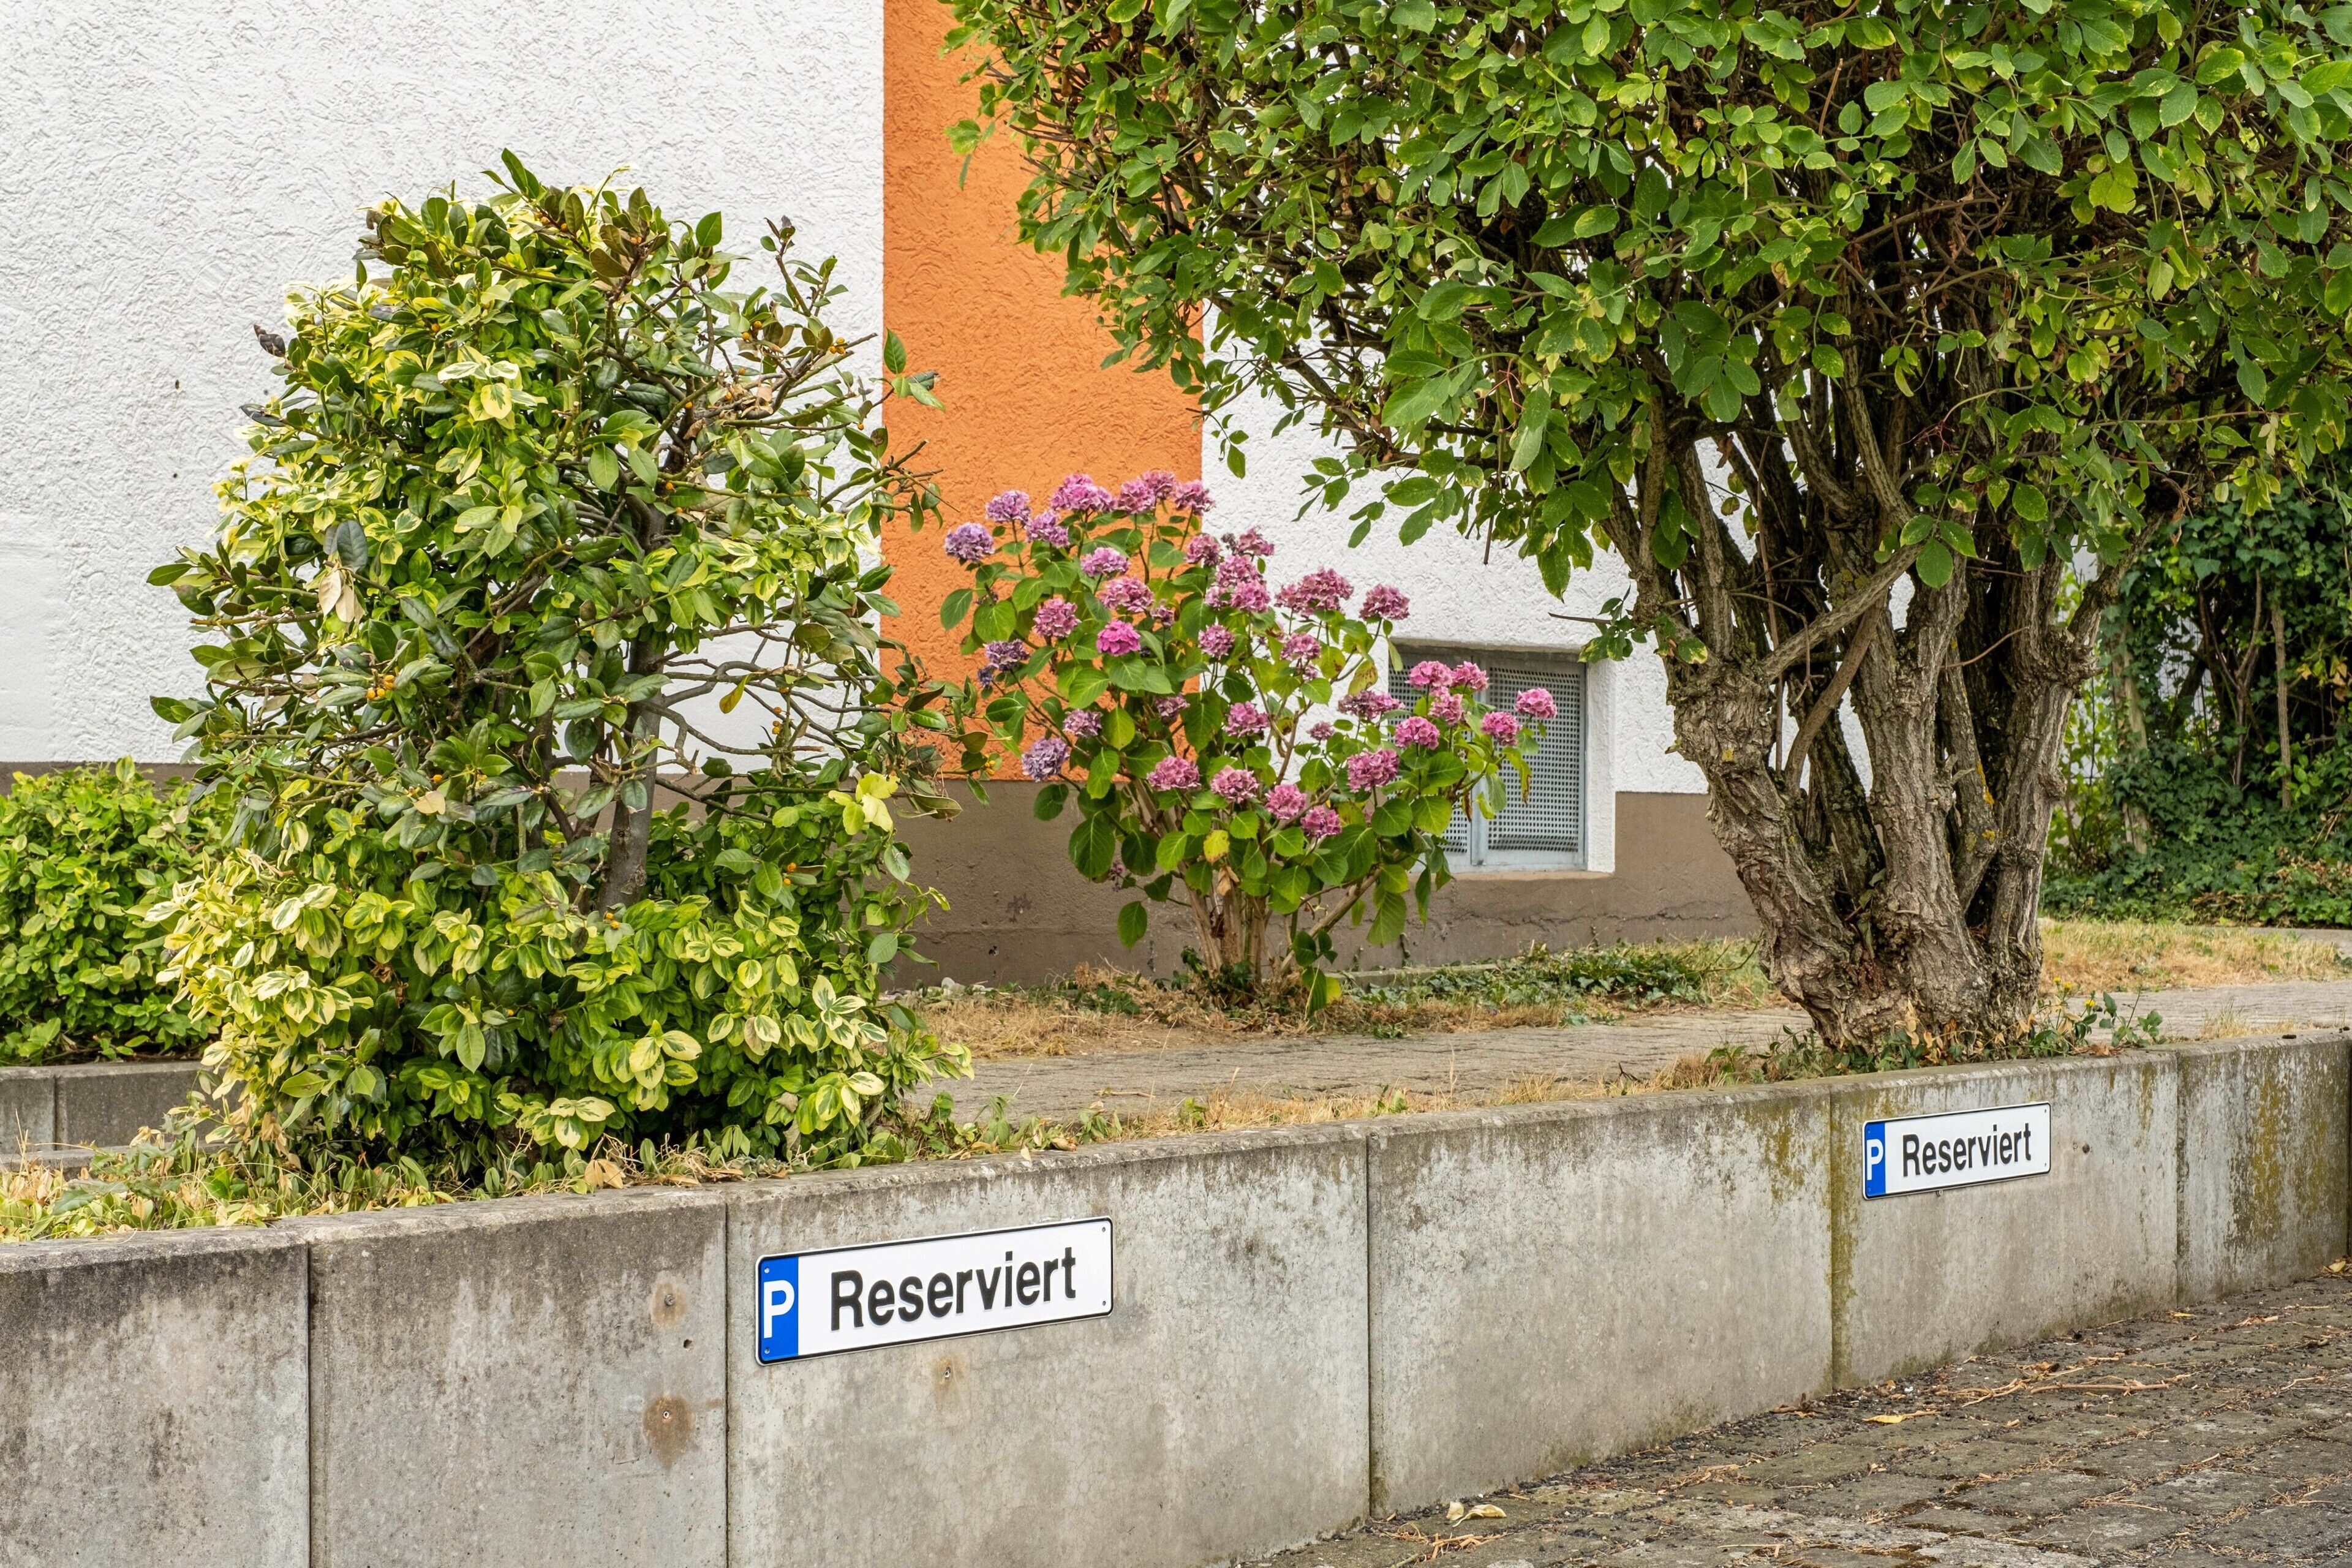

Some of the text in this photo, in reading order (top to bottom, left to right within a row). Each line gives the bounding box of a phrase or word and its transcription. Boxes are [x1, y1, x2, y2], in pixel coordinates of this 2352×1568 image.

[1867, 1123, 2032, 1181] P Reserviert
[763, 1246, 1077, 1339] P Reserviert
